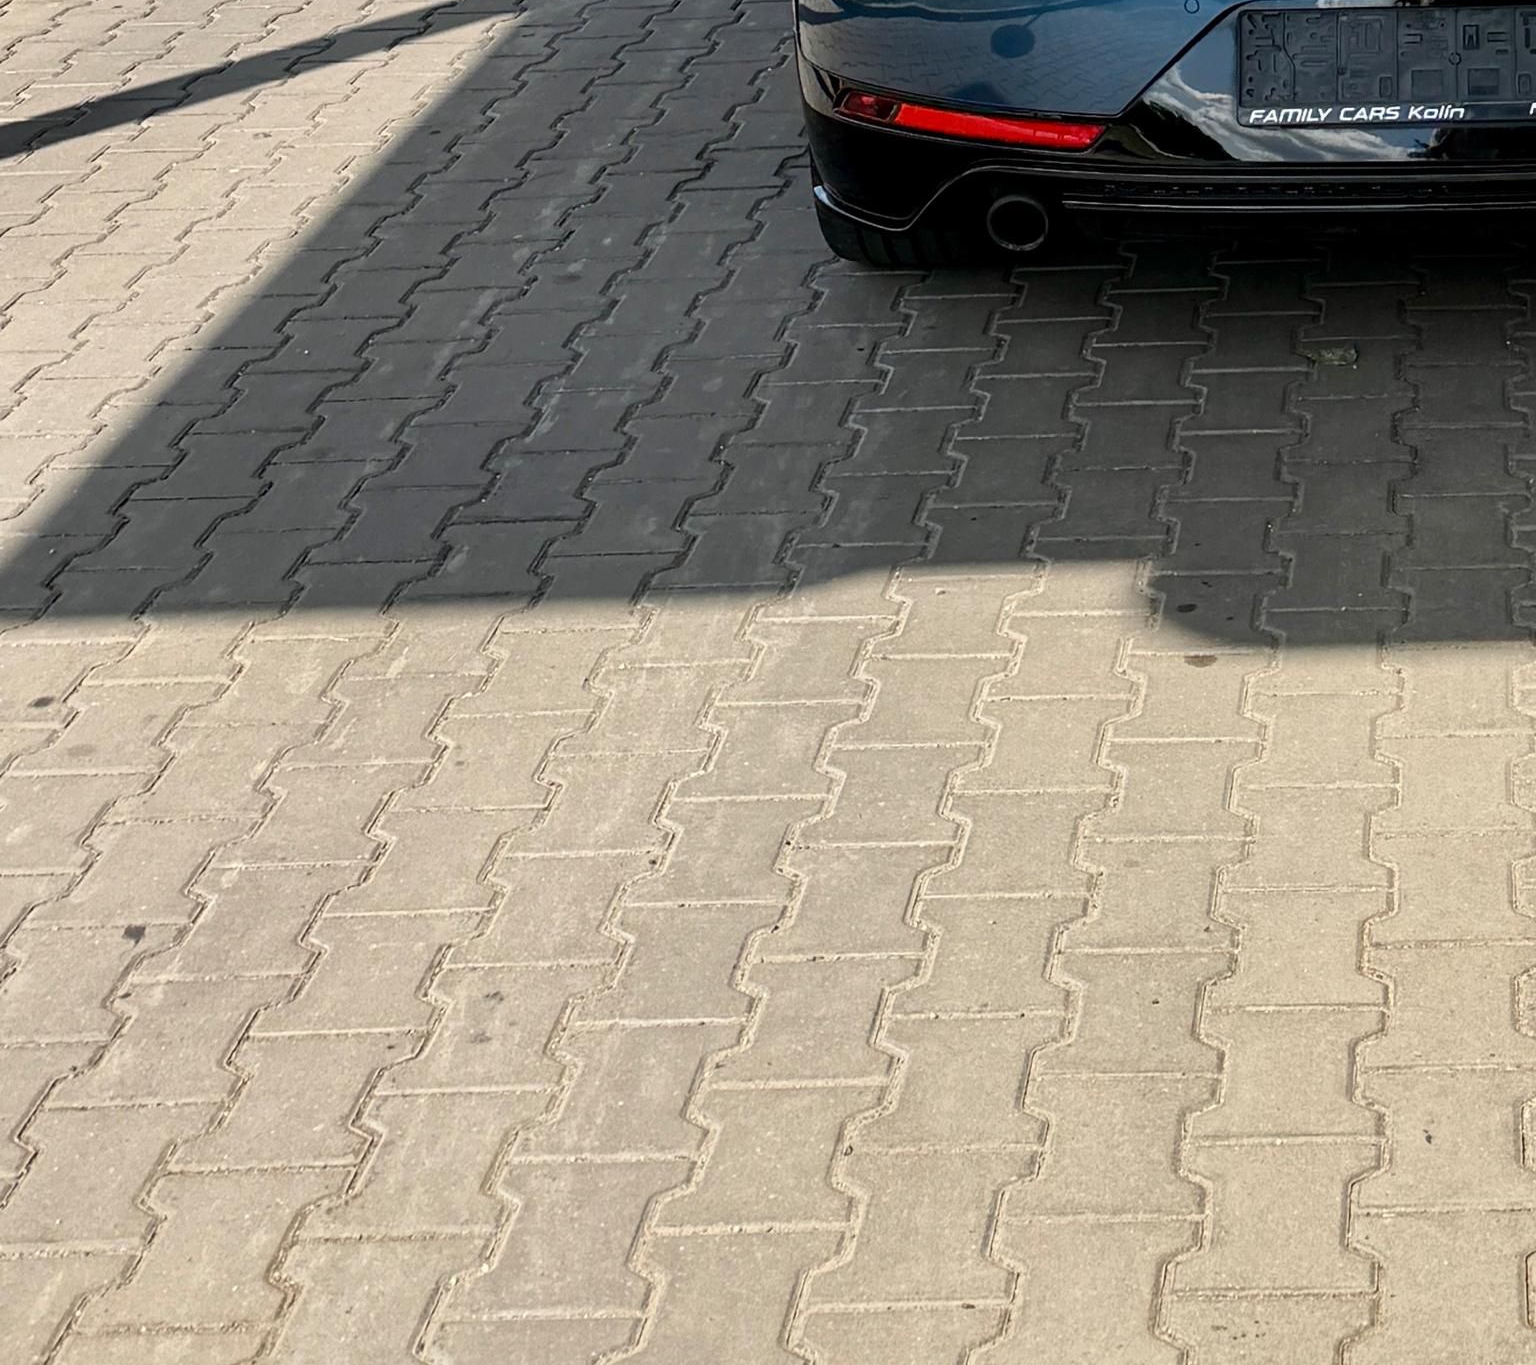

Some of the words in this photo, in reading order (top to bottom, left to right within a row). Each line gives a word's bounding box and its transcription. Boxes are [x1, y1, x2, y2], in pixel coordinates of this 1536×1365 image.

[1249, 107, 1332, 124] FAMILY
[1340, 106, 1401, 121] CARS
[1408, 104, 1465, 120] Kolín
